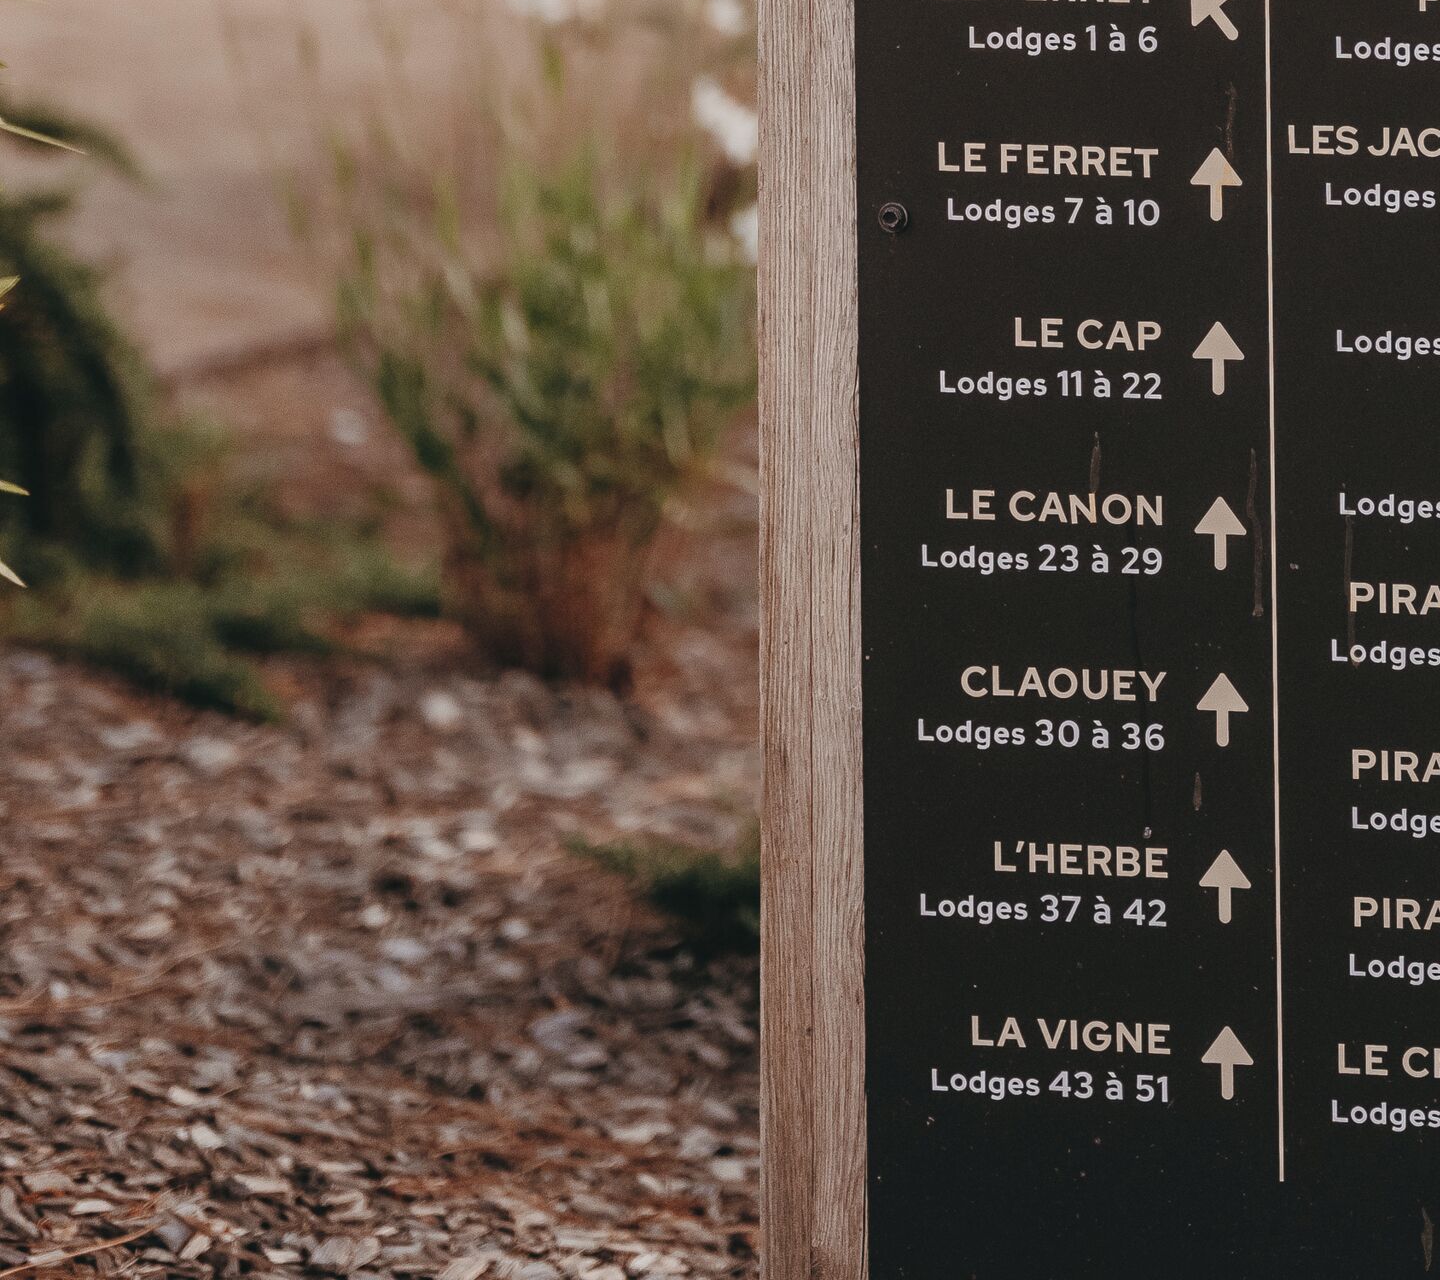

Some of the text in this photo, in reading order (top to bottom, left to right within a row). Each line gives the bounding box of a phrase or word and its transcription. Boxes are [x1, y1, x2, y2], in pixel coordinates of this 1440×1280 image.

[968, 23, 1158, 57] Lodges 1 à 6
[1287, 124, 1360, 156] LES
[937, 141, 1159, 179] LE FERRET
[947, 196, 1160, 229] Lodges 7 à 10
[1325, 182, 1436, 214] Lodges
[1014, 316, 1162, 352] LE CAP
[939, 369, 1163, 401] Lodges 11 à 22
[945, 488, 1163, 526] LE CANON
[921, 543, 1163, 576] Lodges 23 à 29
[960, 665, 1167, 702] CLAOUEY
[917, 718, 1165, 752] Lodges 30 à 36
[919, 892, 1167, 928] Lodges 37 à 42
[971, 1015, 1171, 1055] LA VIGNE
[1337, 1043, 1389, 1076] LE
[931, 1068, 1169, 1103] Lodges 43 à 51
